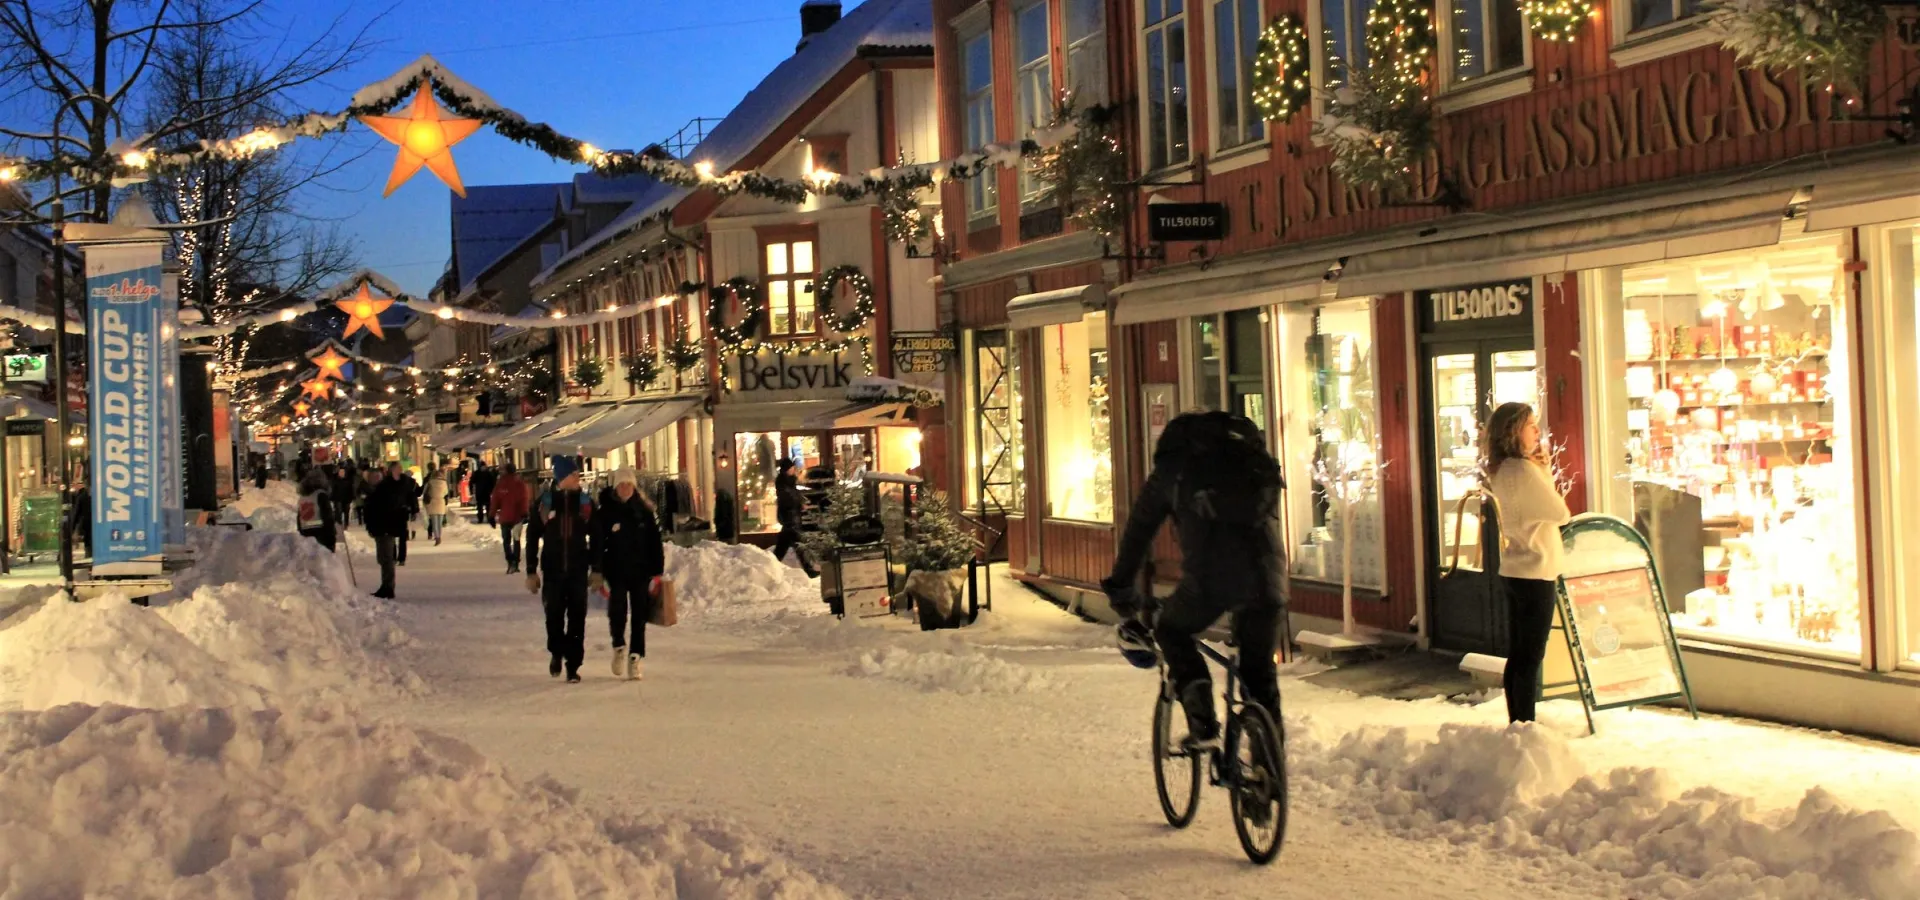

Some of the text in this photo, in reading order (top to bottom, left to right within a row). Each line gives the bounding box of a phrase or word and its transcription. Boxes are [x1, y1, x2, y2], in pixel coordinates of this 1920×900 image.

[1160, 216, 1216, 228] TILBORDS
[1430, 284, 1524, 322] TILBORDS
[103, 309, 130, 384] CUP
[738, 350, 852, 391] Belsvik
[133, 331, 149, 498] LILLEHAMMER
[104, 391, 131, 522] WORLD
